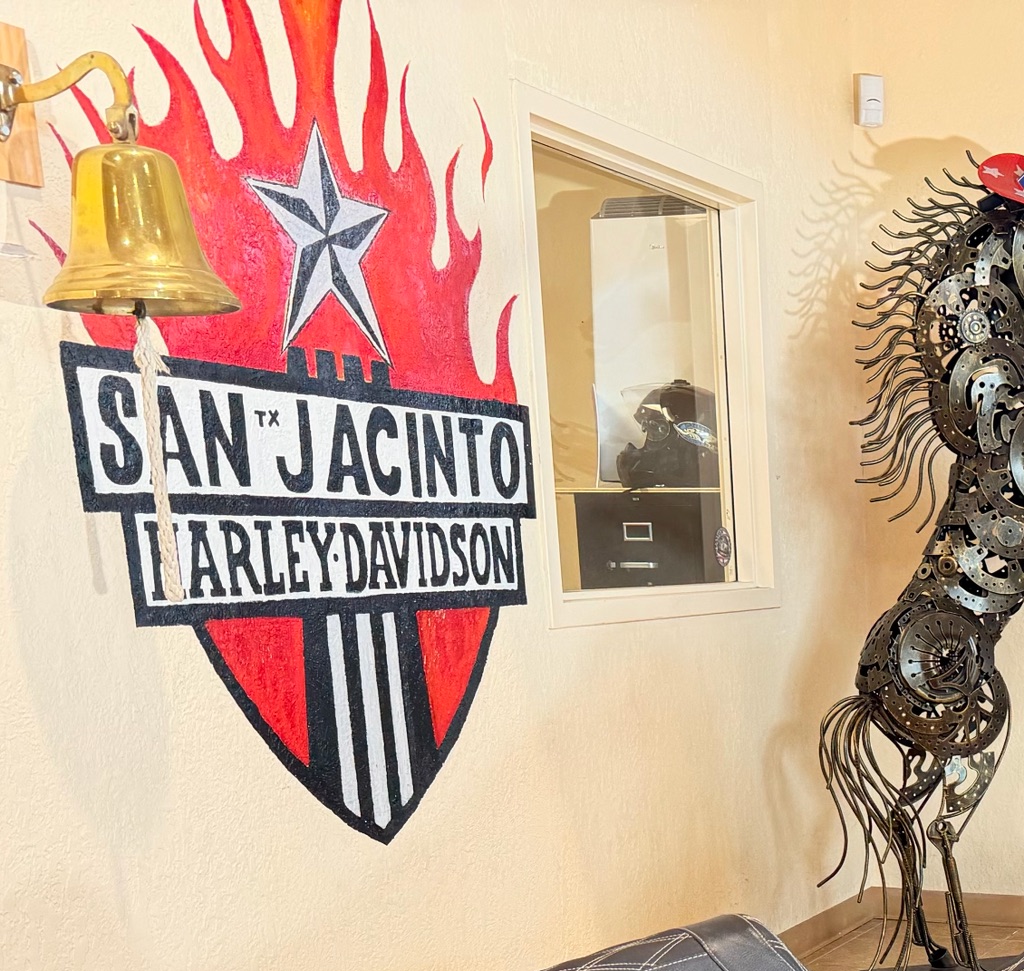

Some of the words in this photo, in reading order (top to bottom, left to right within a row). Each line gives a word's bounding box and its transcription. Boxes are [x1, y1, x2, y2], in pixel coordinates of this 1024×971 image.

[98, 374, 252, 488] SAN
[276, 399, 521, 498] JACINTO
[253, 409, 280, 428] TX
